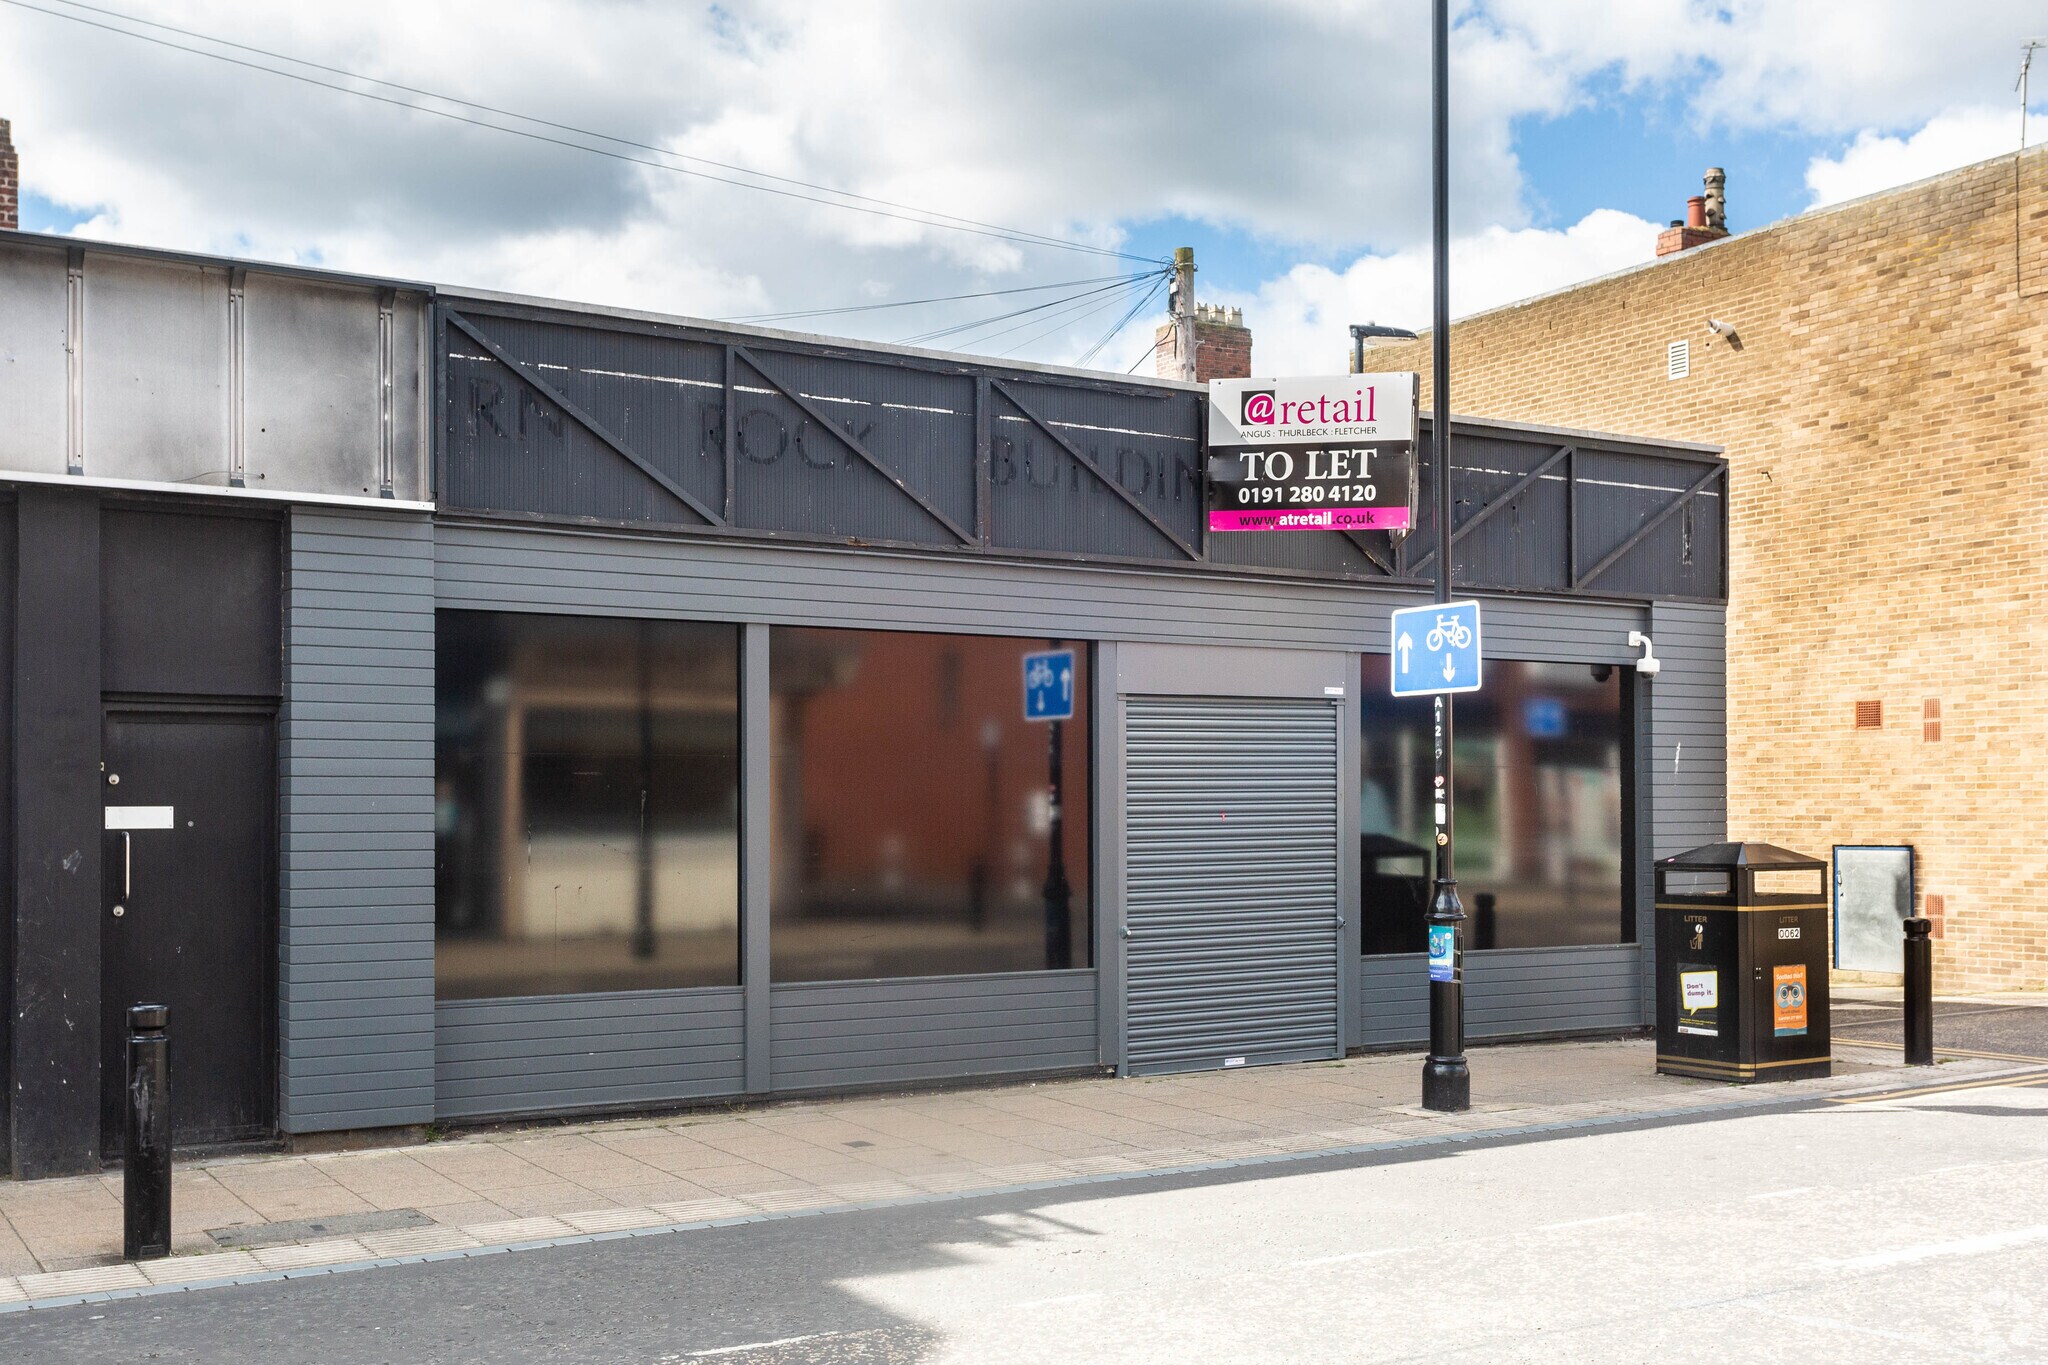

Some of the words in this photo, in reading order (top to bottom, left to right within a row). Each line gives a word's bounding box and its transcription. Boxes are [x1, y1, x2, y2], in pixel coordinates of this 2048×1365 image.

[1279, 428, 1328, 437] THURLBECK
[1334, 426, 1377, 436] FLETCHER
[990, 435, 1199, 501] BUILDIN
[1239, 451, 1294, 481] TO
[1304, 448, 1378, 480] LET
[1238, 487, 1283, 504] 0191
[1289, 486, 1325, 502] 280
[1328, 485, 1377, 502] 4120
[1239, 511, 1375, 526] www.atretail.co.uk
[1684, 915, 1708, 923] LITTER
[1779, 916, 1799, 924] LITTER
[1779, 929, 1800, 939] 0062
